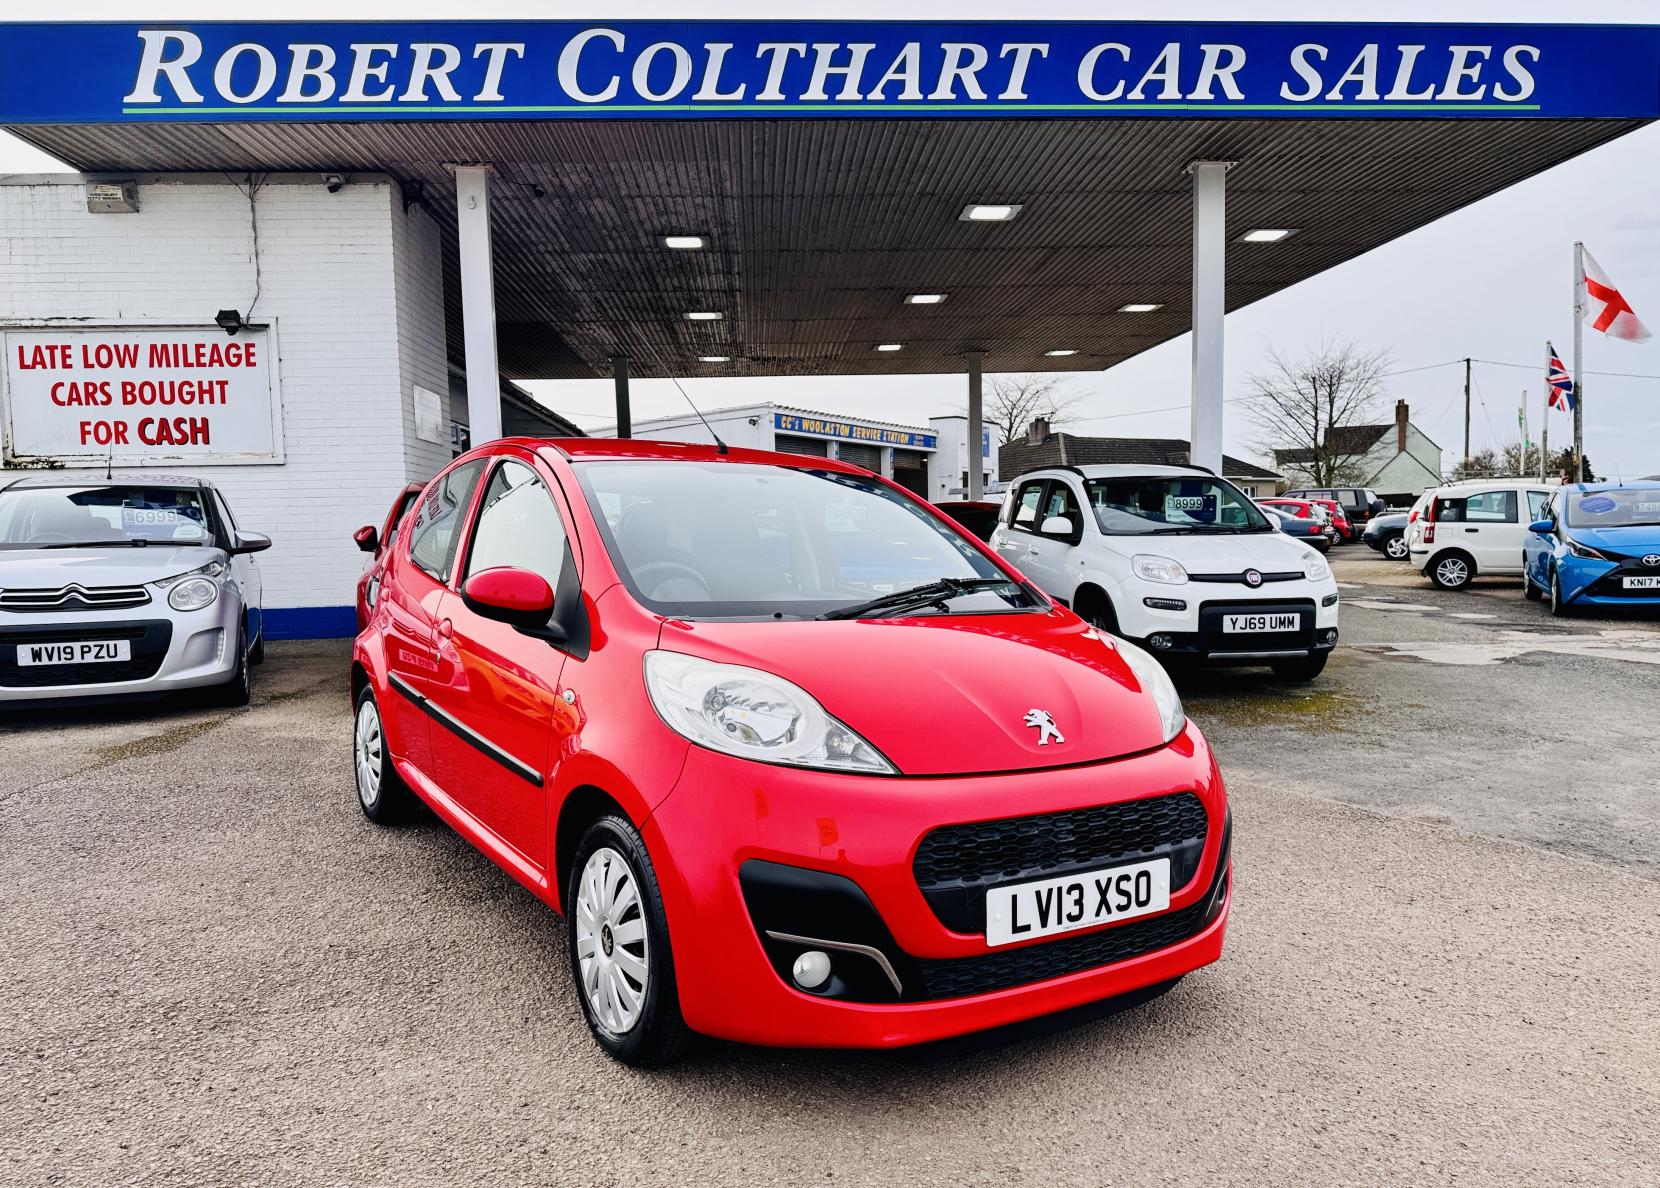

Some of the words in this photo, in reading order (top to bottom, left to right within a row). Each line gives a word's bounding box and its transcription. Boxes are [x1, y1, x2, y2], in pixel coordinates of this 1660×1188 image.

[123, 30, 525, 104] ROBERT
[557, 28, 1050, 103] COLTHART
[1077, 42, 1246, 101] CAR
[1279, 43, 1541, 102] SALES
[18, 345, 73, 370] LATE
[82, 344, 139, 369] LOW
[149, 343, 257, 368] MILEAGE
[50, 381, 113, 407] CARS
[121, 380, 229, 406] BOUGHT
[79, 420, 129, 446] FOR
[137, 416, 210, 446] CASH
[802, 418, 850, 437] WOOLASTON
[852, 425, 881, 440] SERVICE
[883, 430, 909, 444] STATION
[1630, 578, 1653, 587] KN17
[1230, 616, 1266, 631] YJ69
[1269, 615, 1295, 630] UMM
[30, 644, 75, 663] WV19
[80, 643, 118, 661] PZU
[1011, 882, 1085, 935] LV13
[1094, 869, 1152, 918] XSO
